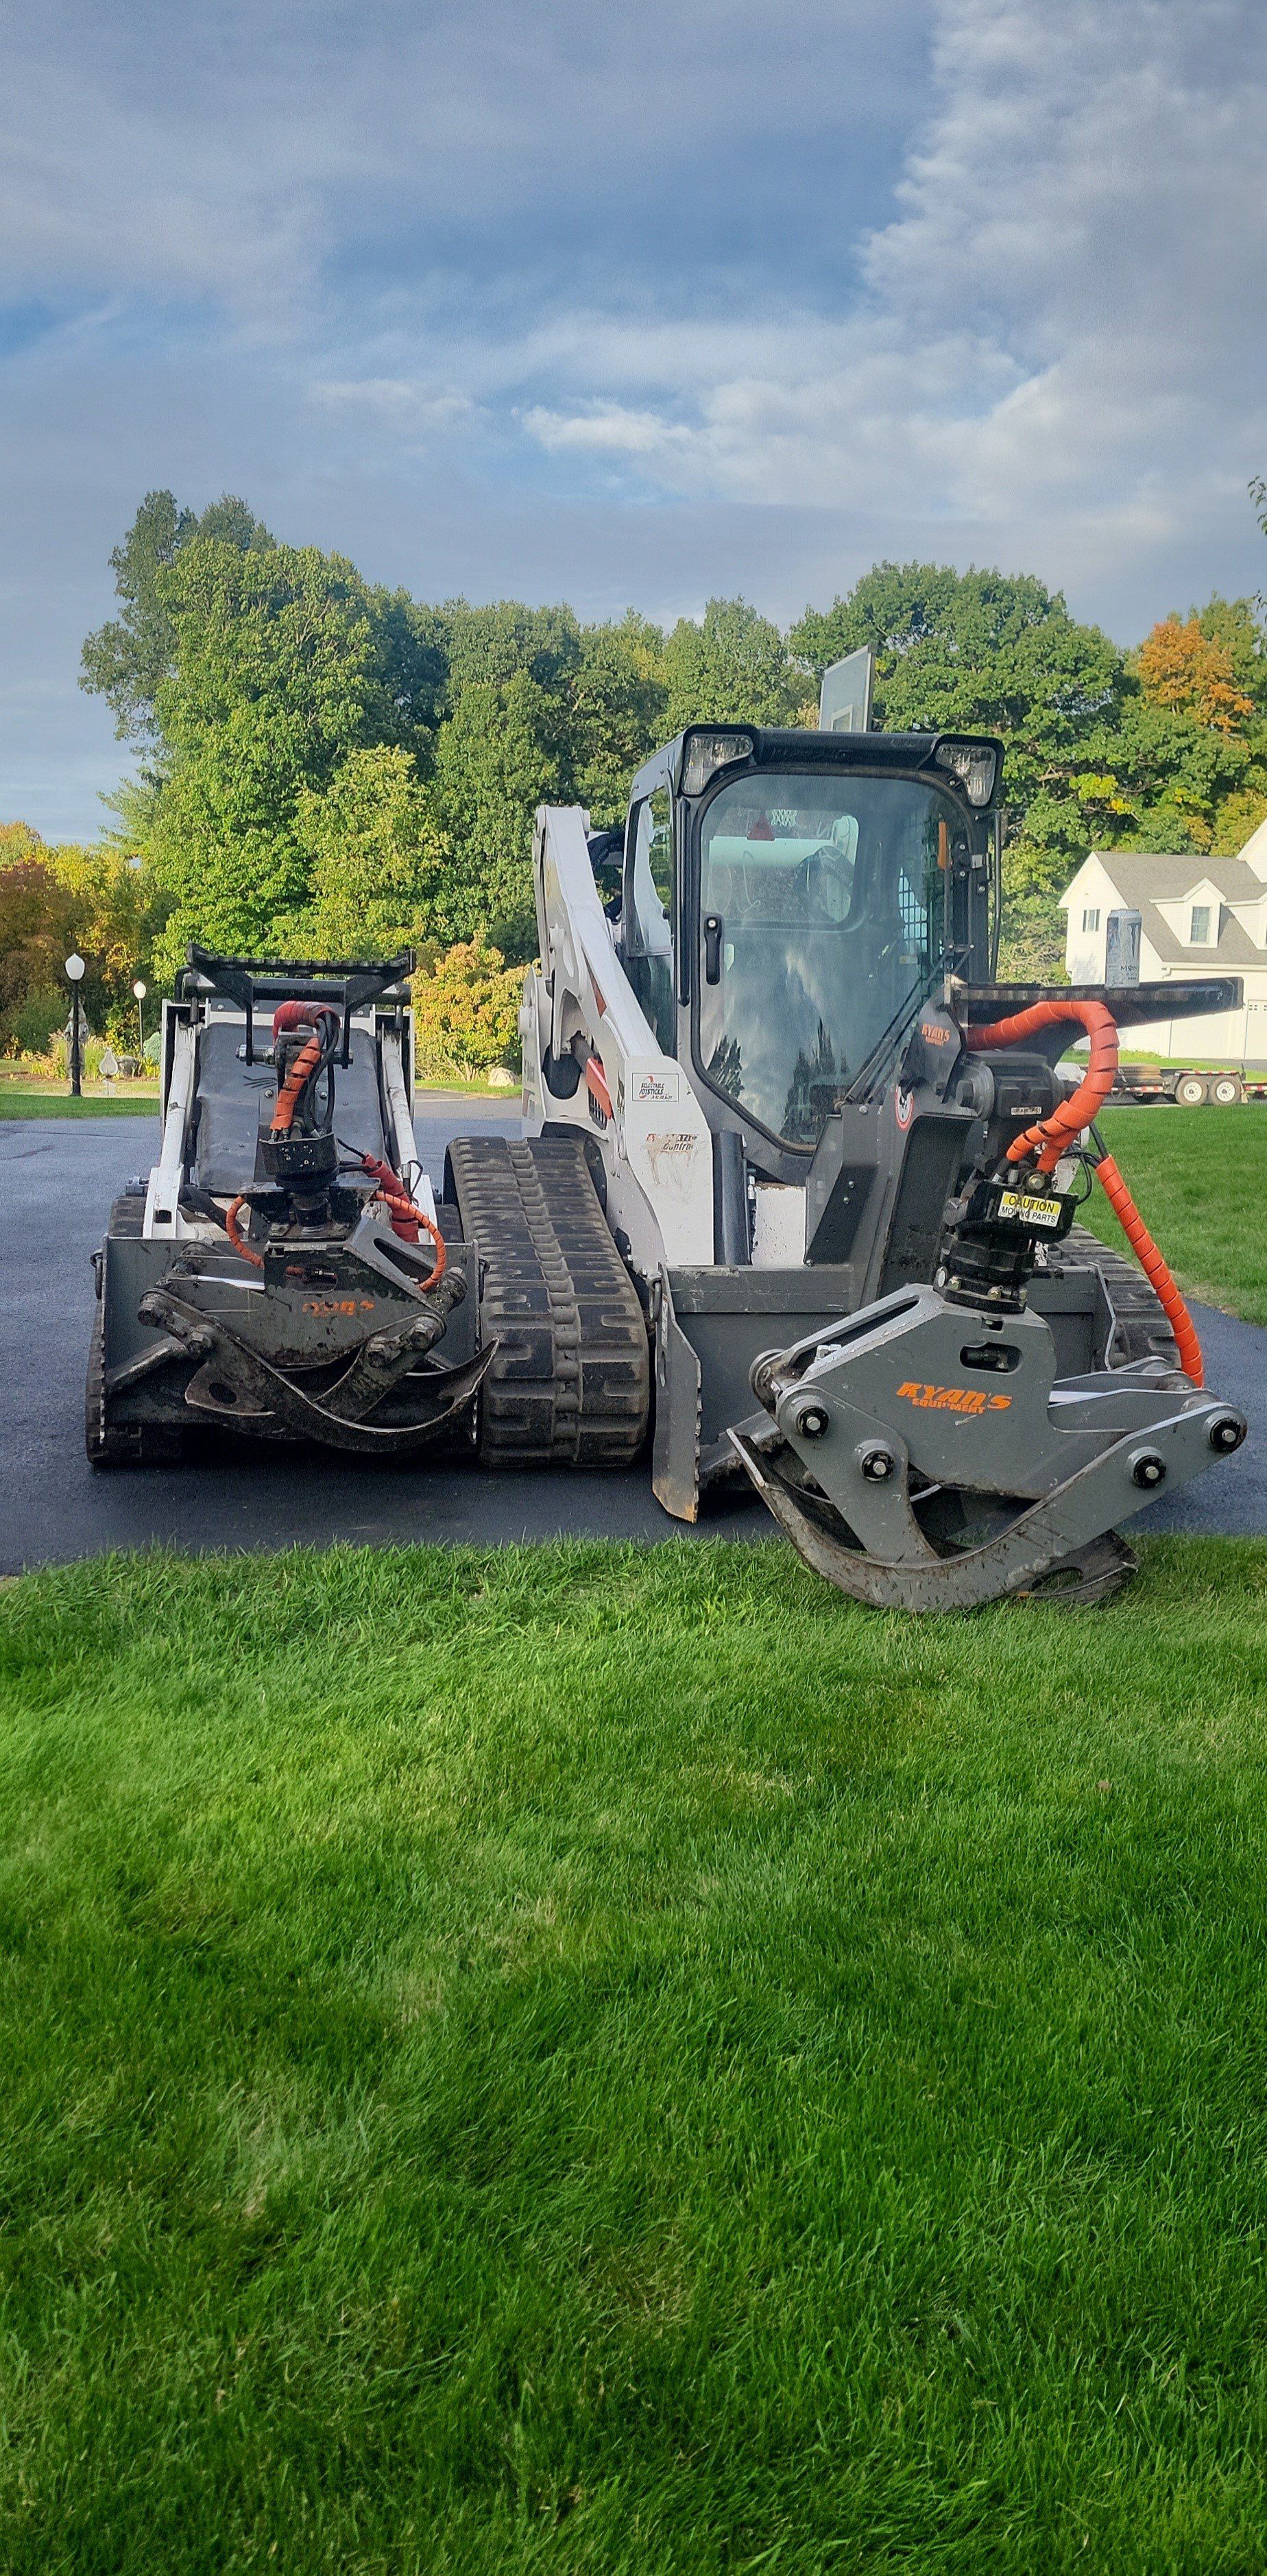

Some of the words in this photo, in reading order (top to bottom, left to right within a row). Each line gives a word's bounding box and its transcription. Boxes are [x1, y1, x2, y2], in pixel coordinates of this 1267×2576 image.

[1009, 1195, 1054, 1213] CAUTION
[1001, 1206, 1030, 1219] MONG
[1032, 1212, 1056, 1223] PARTS
